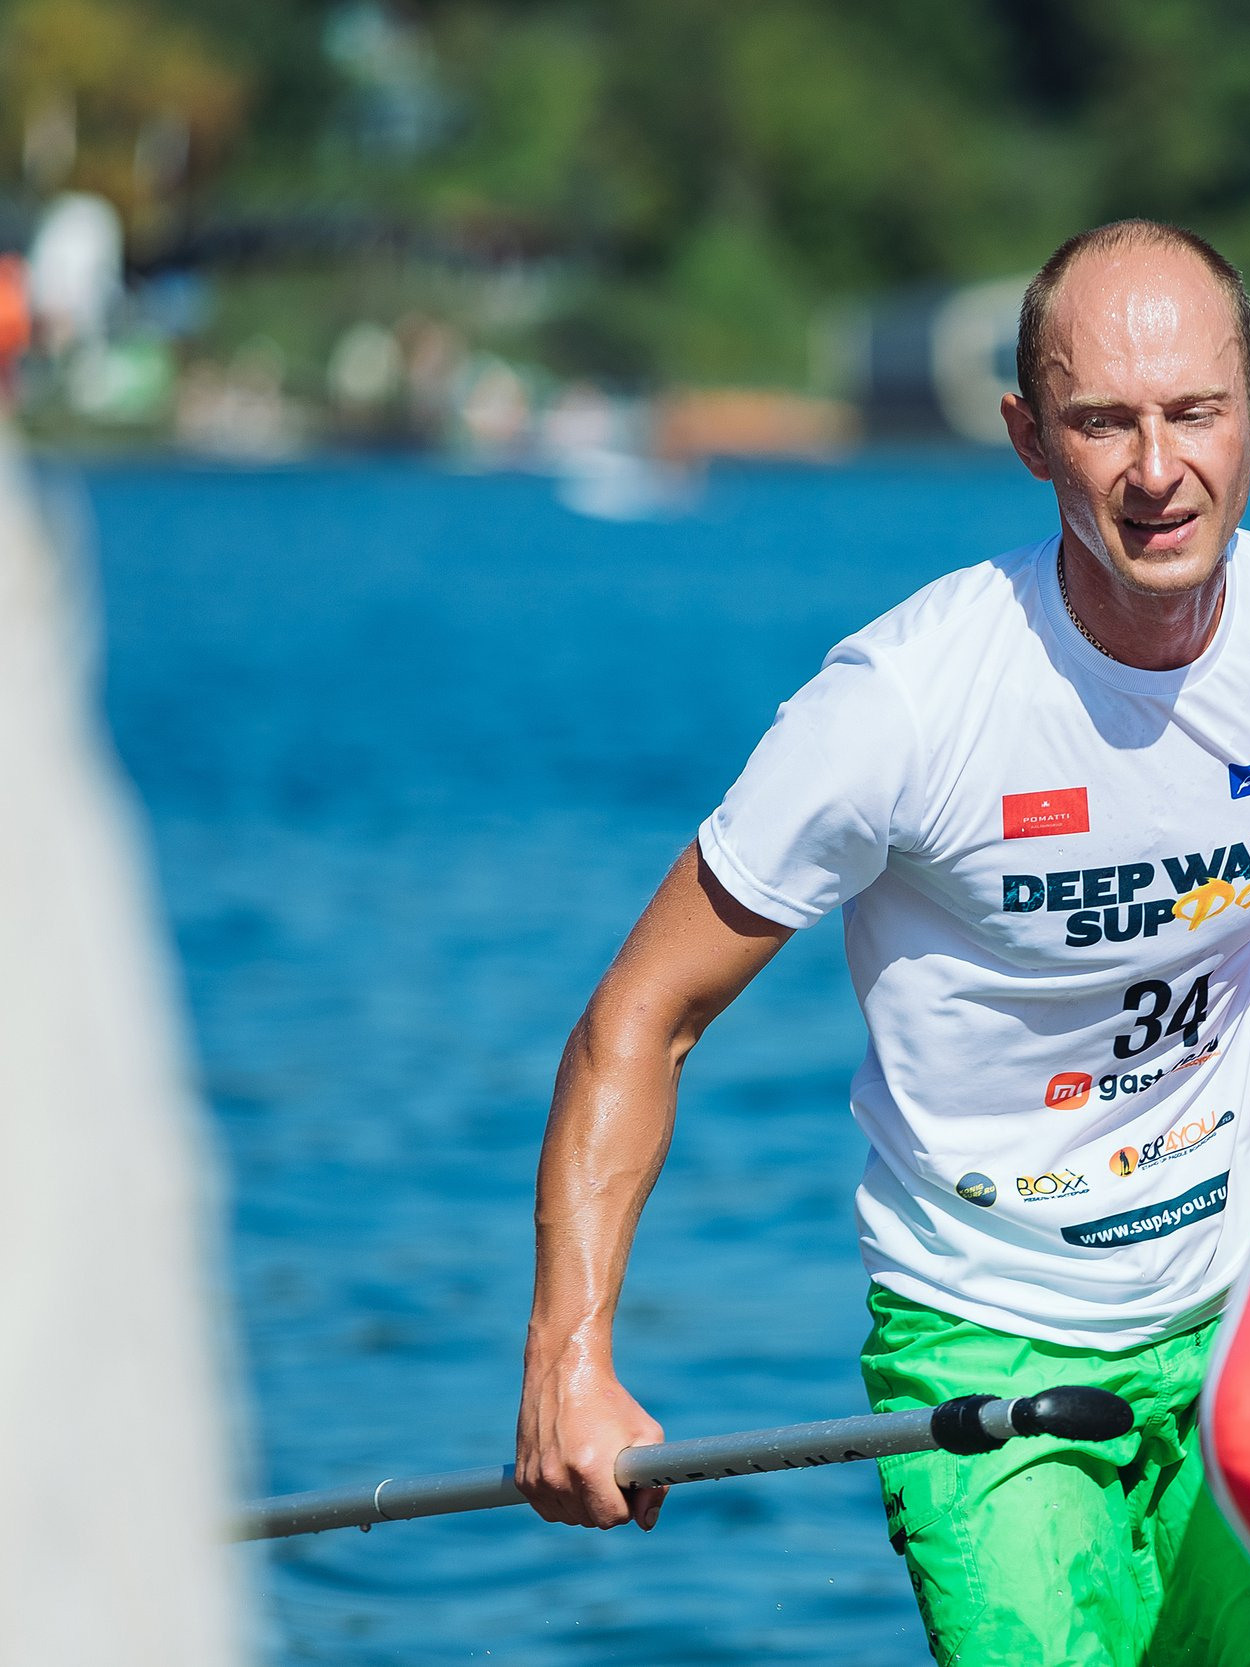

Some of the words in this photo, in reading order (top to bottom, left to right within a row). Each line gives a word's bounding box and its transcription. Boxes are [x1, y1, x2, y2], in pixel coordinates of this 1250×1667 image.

[1023, 813, 1070, 823] POMATTI
[1002, 862, 1154, 913] DEEP
[1065, 898, 1176, 948] SUP
[1113, 970, 1214, 1060] 34
[1080, 1185, 1227, 1245] www.sup4you.ru
